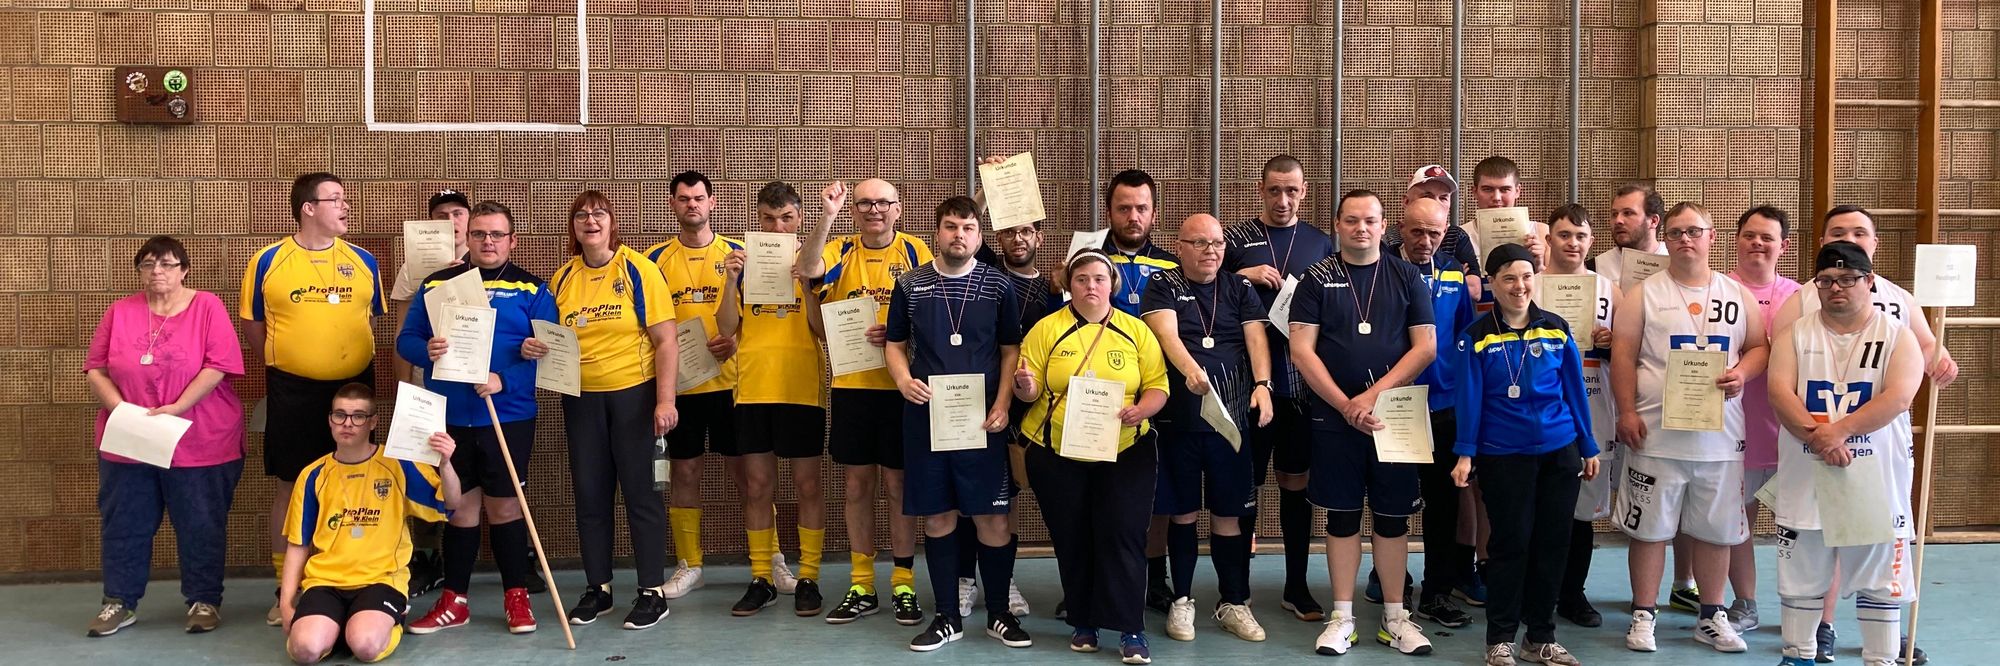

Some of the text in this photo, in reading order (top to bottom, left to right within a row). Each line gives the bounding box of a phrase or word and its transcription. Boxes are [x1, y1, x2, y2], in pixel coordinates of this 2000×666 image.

[308, 285, 353, 294] ProPlan
[580, 303, 622, 314] ProPlan
[1708, 298, 1739, 325] 30
[455, 314, 479, 322] Urkunde
[1858, 341, 1884, 369] 11
[1085, 388, 1109, 396] Urkunde
[1631, 469, 1649, 482] EASY
[342, 507, 381, 517] ProPlan
